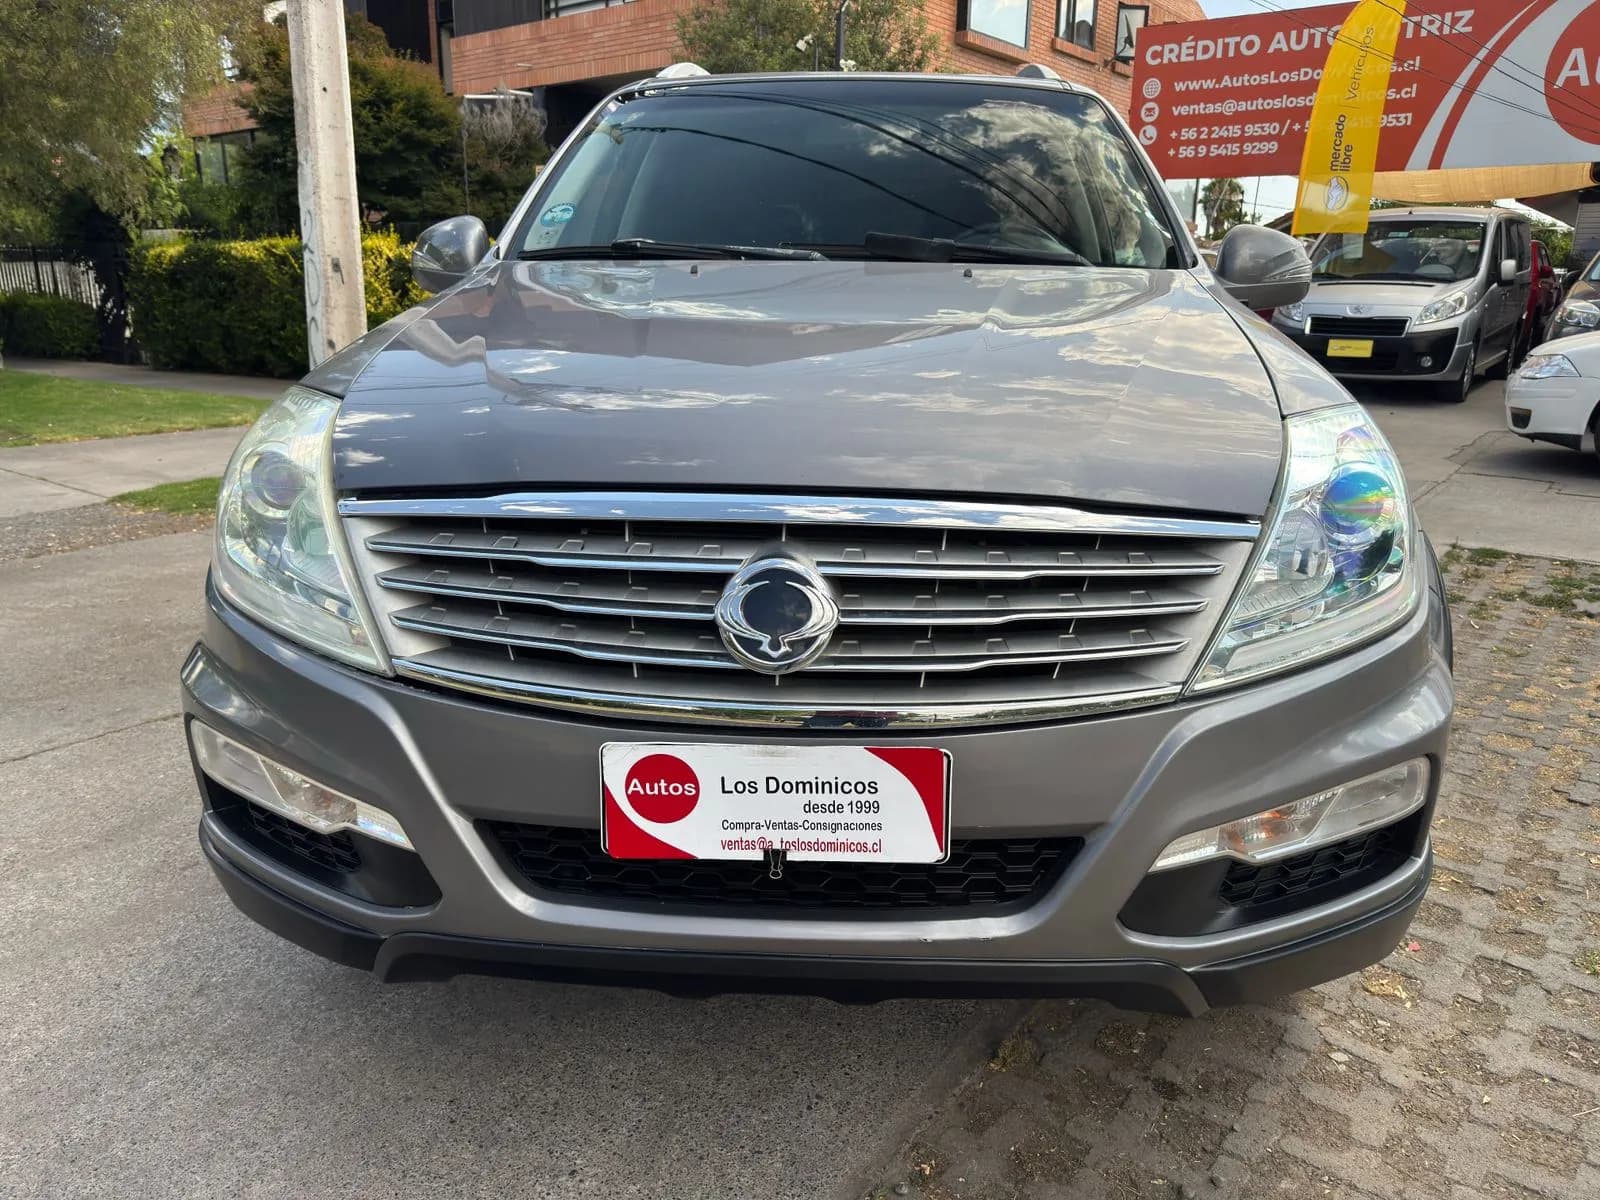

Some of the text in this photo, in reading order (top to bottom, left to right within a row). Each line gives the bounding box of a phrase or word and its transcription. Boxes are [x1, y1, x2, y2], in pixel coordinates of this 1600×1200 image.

[1145, 9, 1475, 66] CRÉDITO AUTOTRIZ
[1180, 128, 1198, 140] 56
[1199, 127, 1209, 139] 2
[1211, 124, 1242, 138] 2415
[1244, 121, 1280, 137] 9530
[1379, 113, 1413, 127] 9531
[1178, 145, 1196, 158] 56
[1198, 144, 1207, 157] 9
[1209, 142, 1240, 156] 5415
[1243, 141, 1279, 155] 9299
[1330, 113, 1347, 172] mercado
[1339, 144, 1353, 172] libre
[627, 778, 697, 796] Autos
[720, 776, 879, 795] Los Dominicos
[803, 800, 880, 814] desde 1999
[720, 836, 883, 853] ventas@atoslosdominicos.cl
